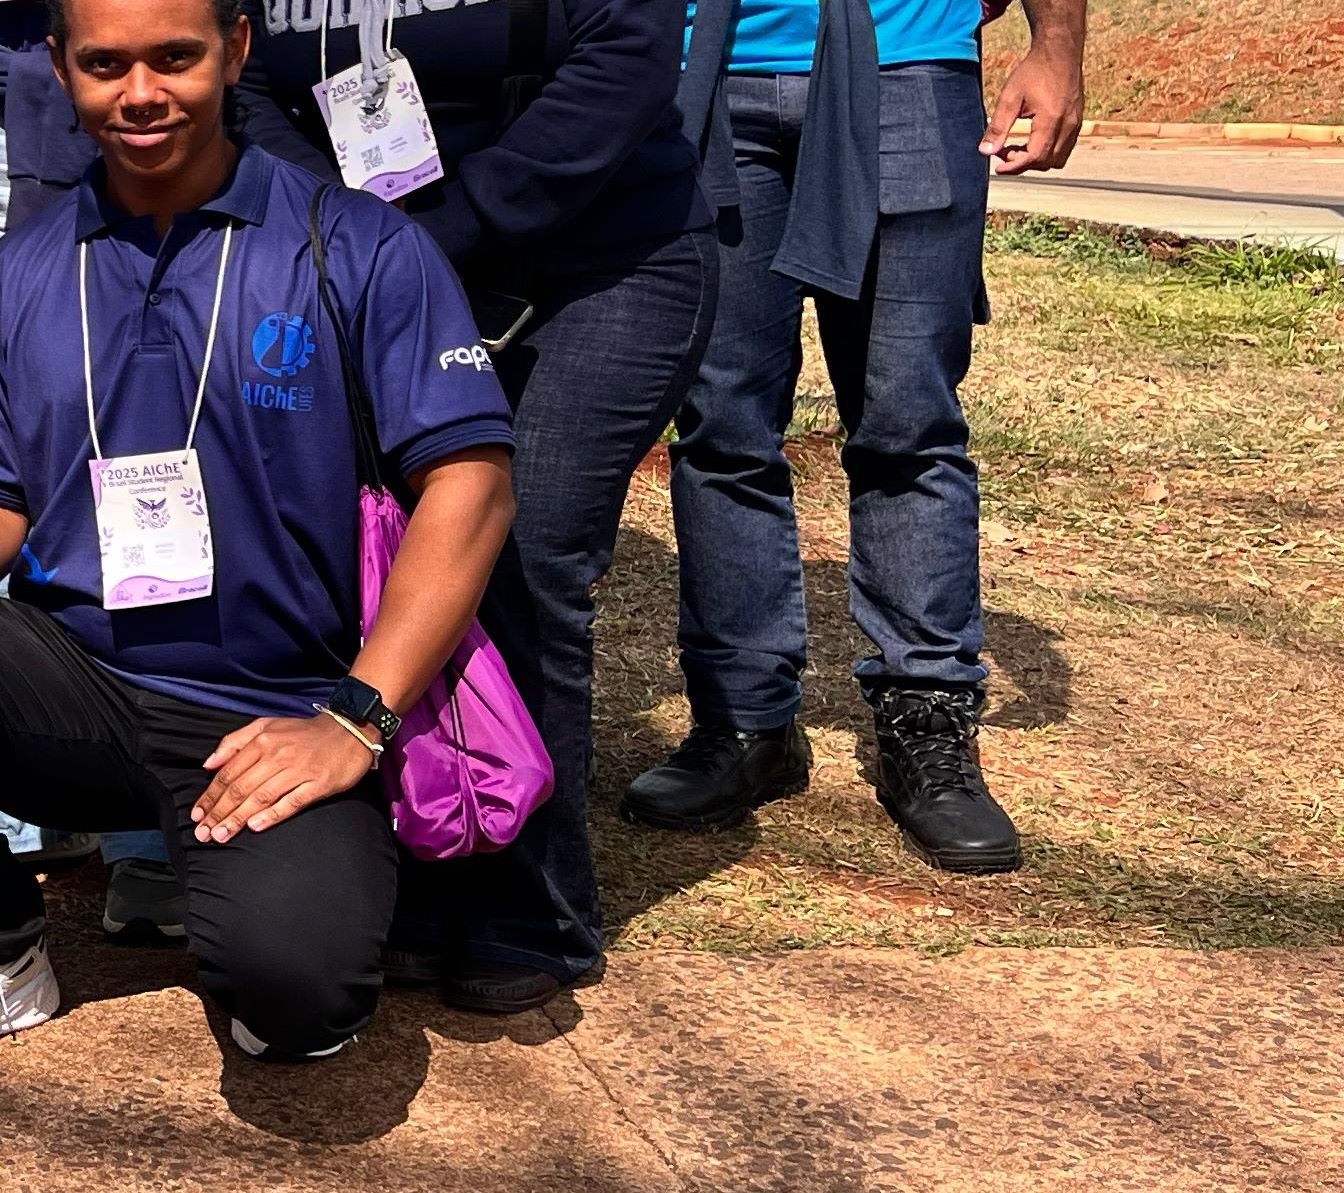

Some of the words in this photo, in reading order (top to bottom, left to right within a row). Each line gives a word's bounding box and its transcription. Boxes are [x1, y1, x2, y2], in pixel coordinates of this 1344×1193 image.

[330, 78, 358, 98] 2025
[242, 381, 298, 411] AIChE
[107, 467, 138, 480] 2025
[143, 462, 181, 477] AIChE
